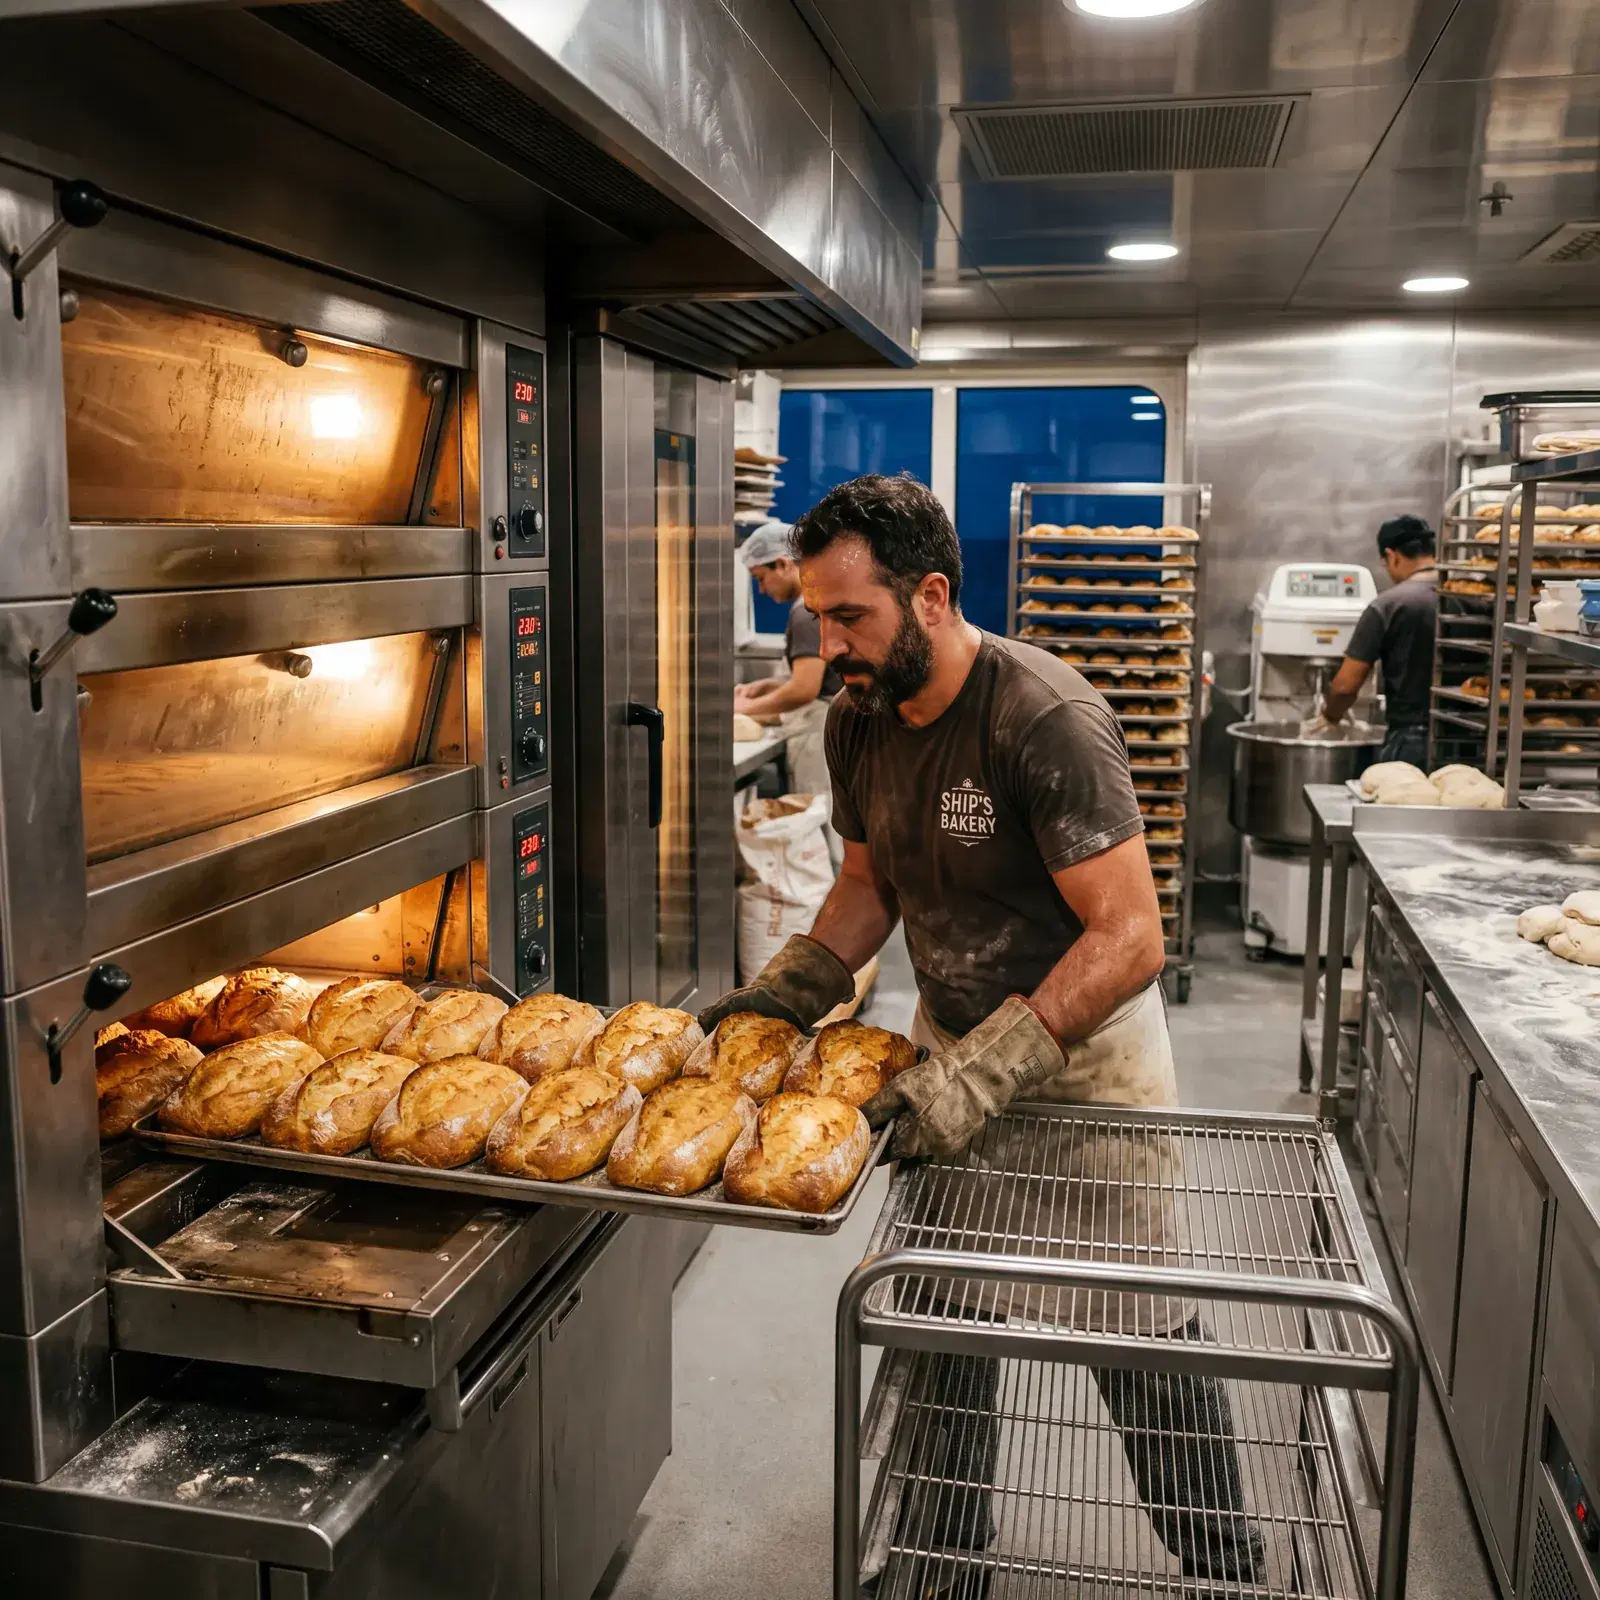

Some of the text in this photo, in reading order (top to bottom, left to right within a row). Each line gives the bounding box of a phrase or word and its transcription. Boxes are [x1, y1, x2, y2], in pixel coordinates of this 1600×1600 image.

[515, 382, 533, 401] 230
[518, 617, 535, 636] 230
[941, 792, 993, 816] SHIP'S
[941, 813, 996, 834] BAKERY
[521, 834, 538, 857] 230
